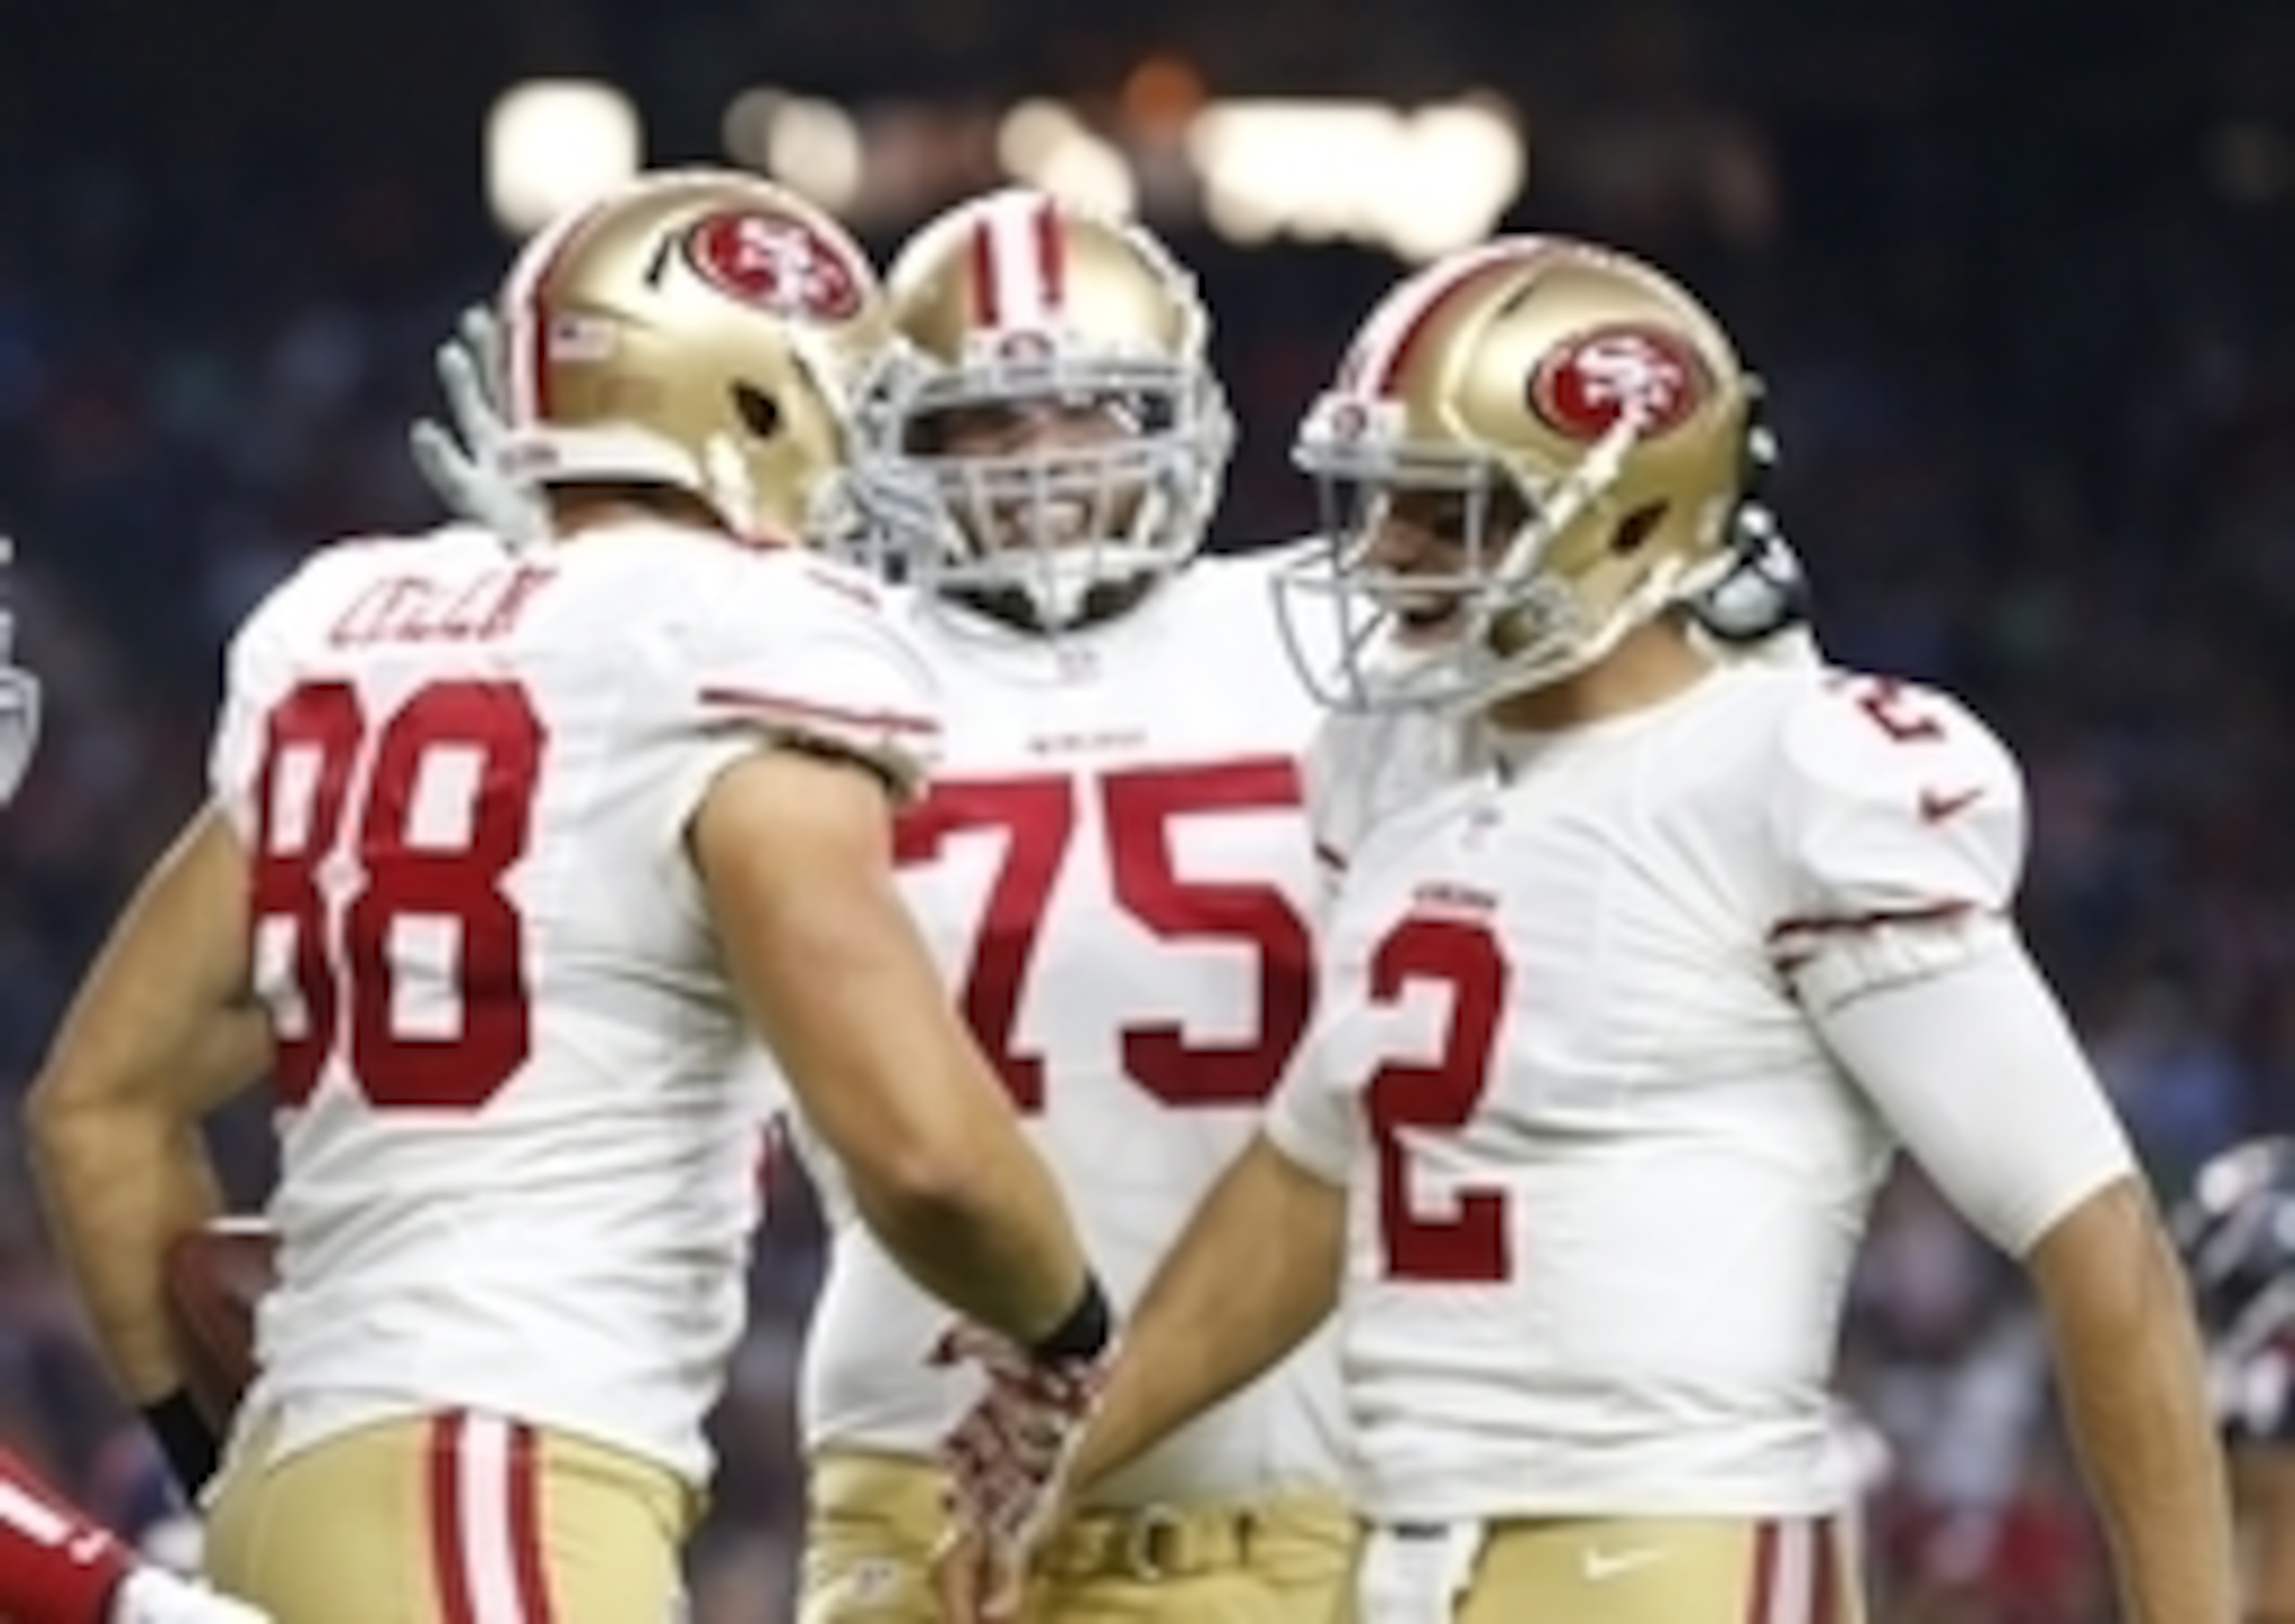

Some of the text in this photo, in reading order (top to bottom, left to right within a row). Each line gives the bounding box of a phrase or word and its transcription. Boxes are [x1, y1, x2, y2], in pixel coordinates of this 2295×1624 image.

[251, 678, 547, 1111] 88
[891, 755, 1320, 1115] 75
[1364, 918, 1513, 1283] 2
